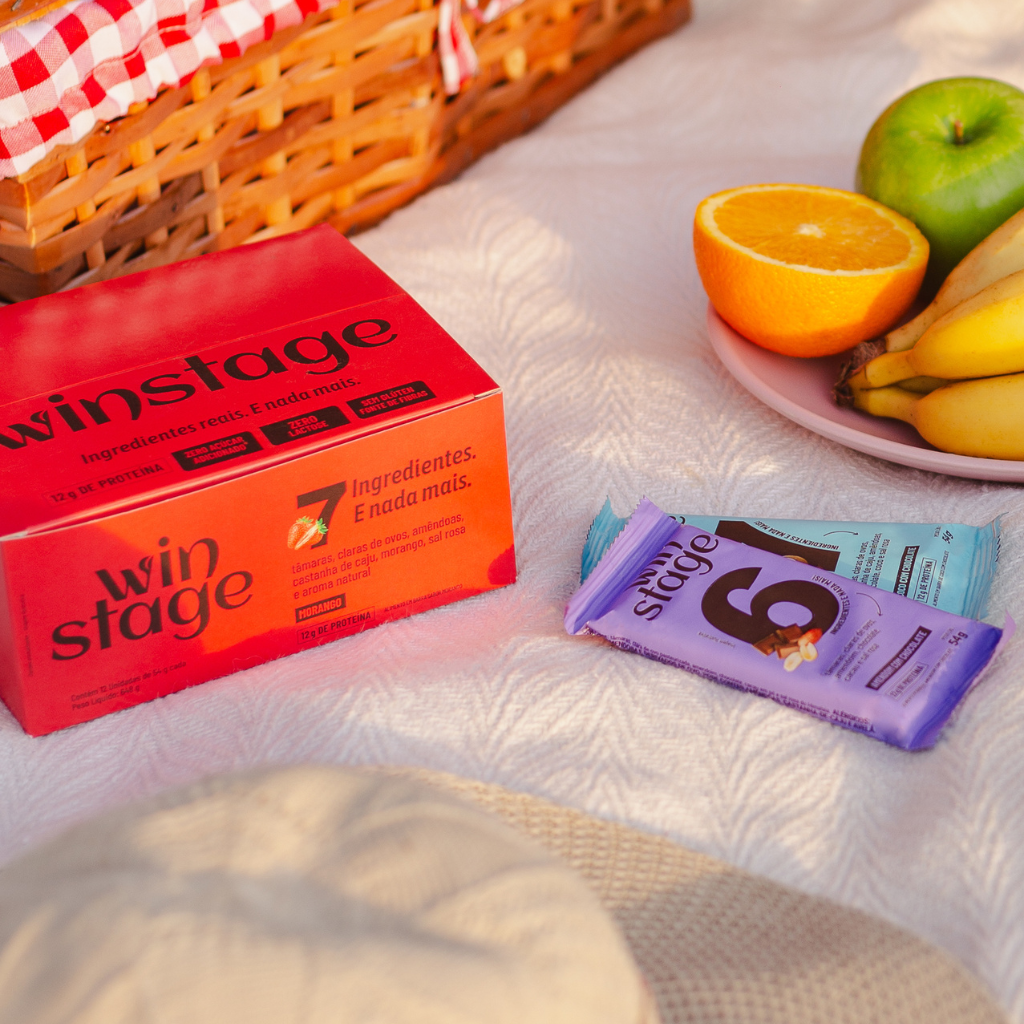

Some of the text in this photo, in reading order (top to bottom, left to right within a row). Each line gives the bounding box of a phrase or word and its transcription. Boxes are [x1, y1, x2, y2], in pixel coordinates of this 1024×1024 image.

[0, 318, 398, 450] winstage
[359, 390, 428, 415] FONTE DE FIBRAS
[361, 396, 381, 407] SEM
[80, 378, 361, 464] Ingredientes reais. E nada mais.
[287, 415, 318, 430] ZERO
[287, 421, 329, 437] LACTOSE
[184, 447, 209, 458] ZERO
[51, 463, 164, 503] 12 g DE PROTEÍNA
[352, 446, 477, 498] Ingredientes.
[297, 480, 347, 550] 7
[354, 474, 472, 523] E nada mais.
[292, 513, 464, 574] tâmaras, claras de ovos, amêndoas,
[293, 526, 466, 587] castanha de caju, morango, sal rosa
[790, 536, 839, 550] INGREDIENTES
[95, 536, 219, 602] win
[293, 567, 371, 600] e aroma natural
[633, 534, 719, 621] stage
[52, 571, 253, 661] stage
[299, 596, 342, 619] MORANGO
[301, 611, 371, 640] 12 g DE PROTEÍNA
[701, 567, 839, 647] 6
[899, 628, 928, 662] CHOCOLATE
[947, 628, 968, 649] 54g
[169, 661, 186, 671] cada
